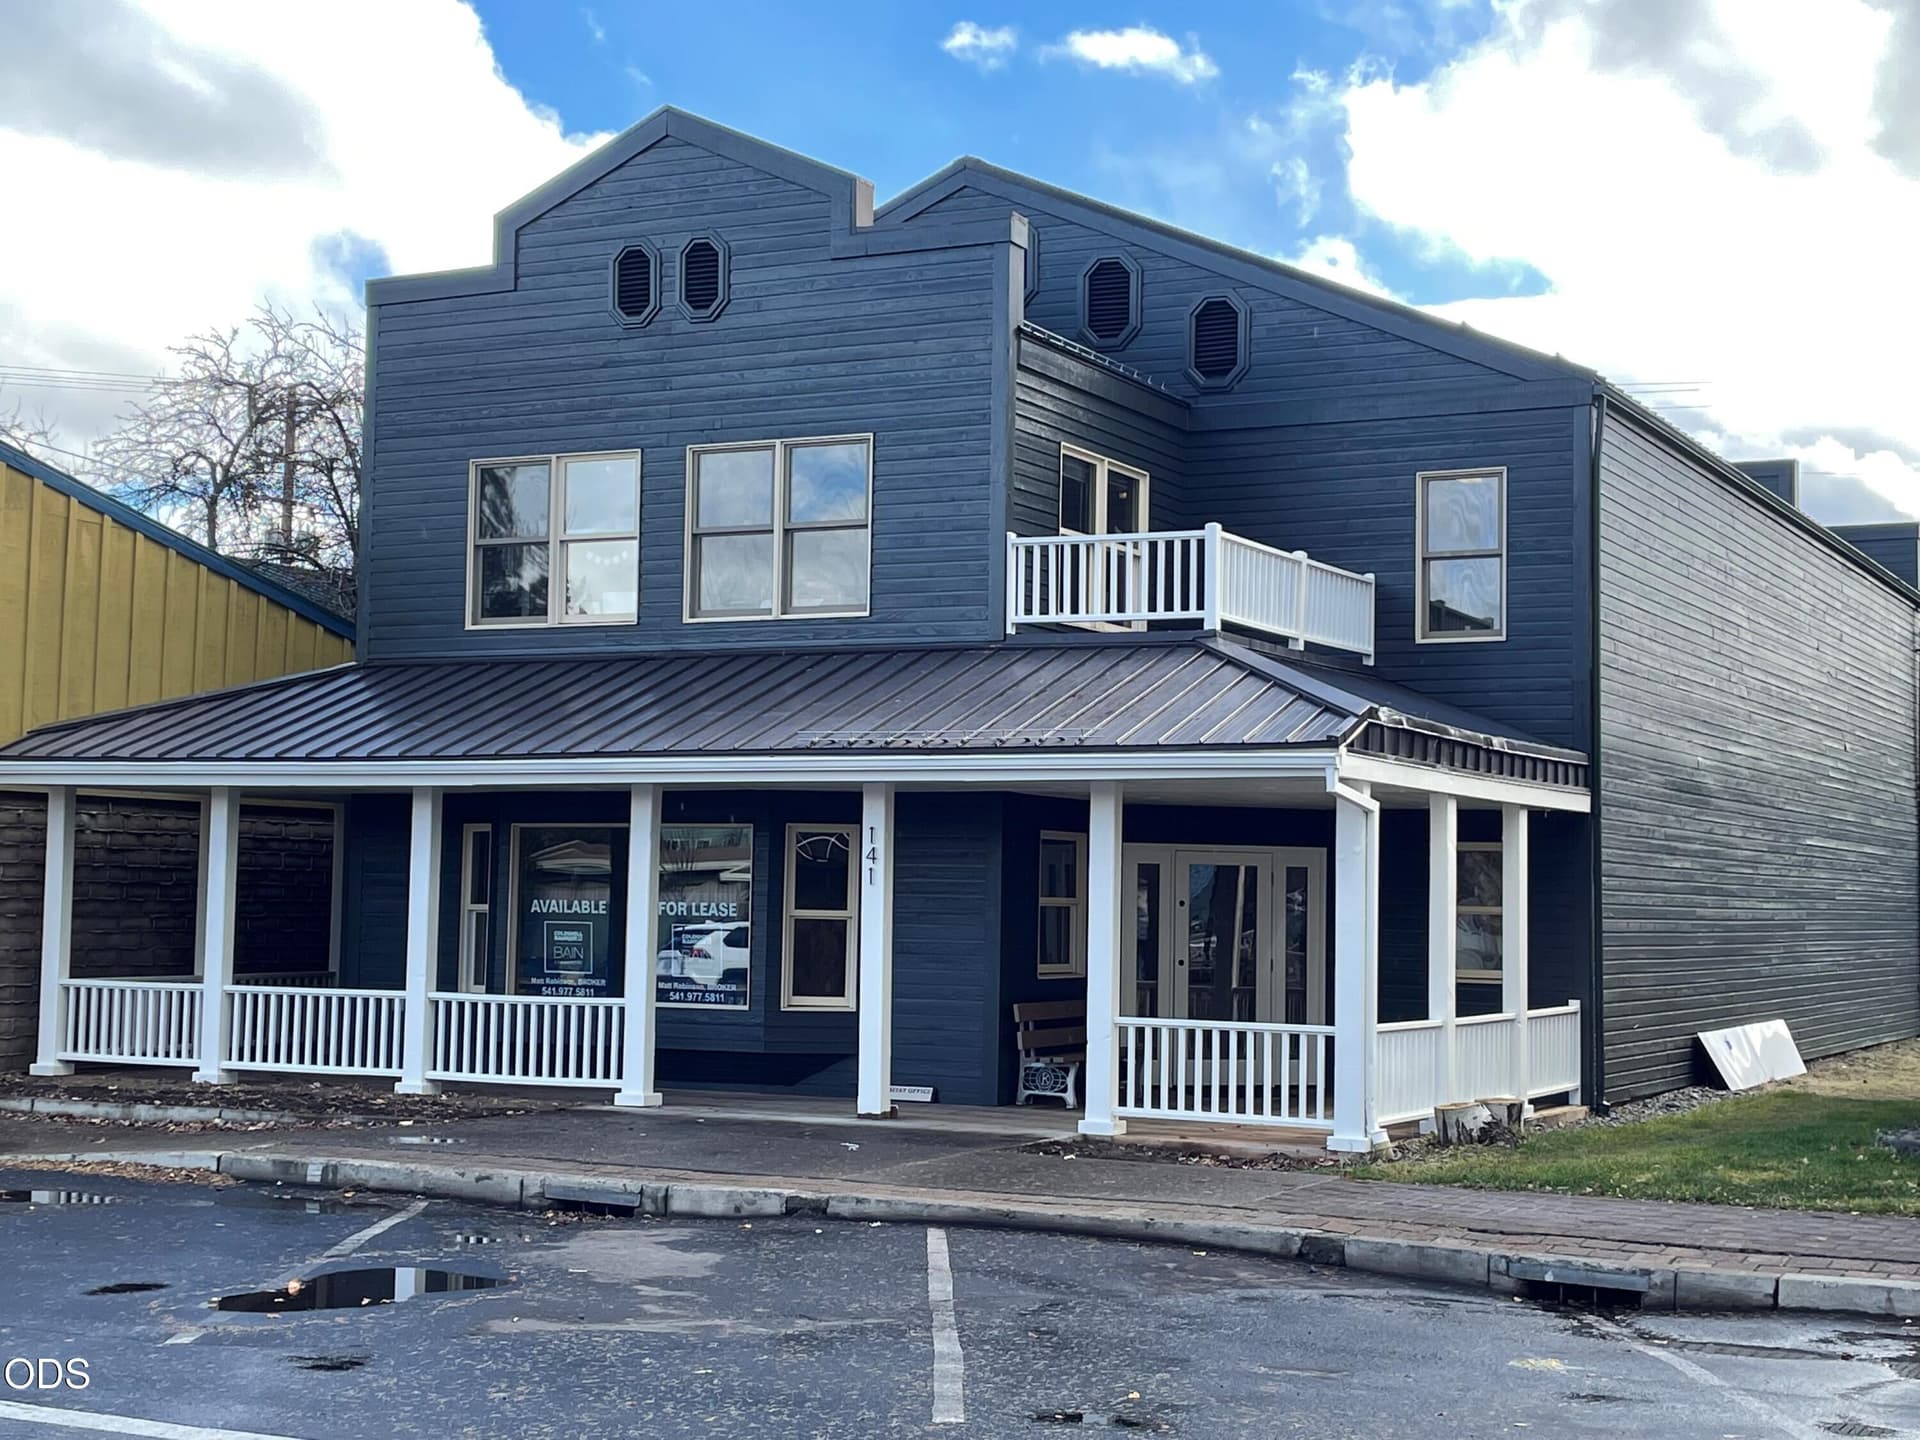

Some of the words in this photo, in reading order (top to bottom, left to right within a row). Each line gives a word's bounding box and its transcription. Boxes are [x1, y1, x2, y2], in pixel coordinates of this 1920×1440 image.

[865, 826, 878, 886] 141
[530, 899, 607, 914] AVAILABLE
[658, 901, 687, 916] FOR
[692, 902, 737, 917] LEASE
[553, 945, 584, 960] BAIN
[541, 986, 595, 996] 541.977.5811
[669, 991, 725, 1002] 541.977.5811
